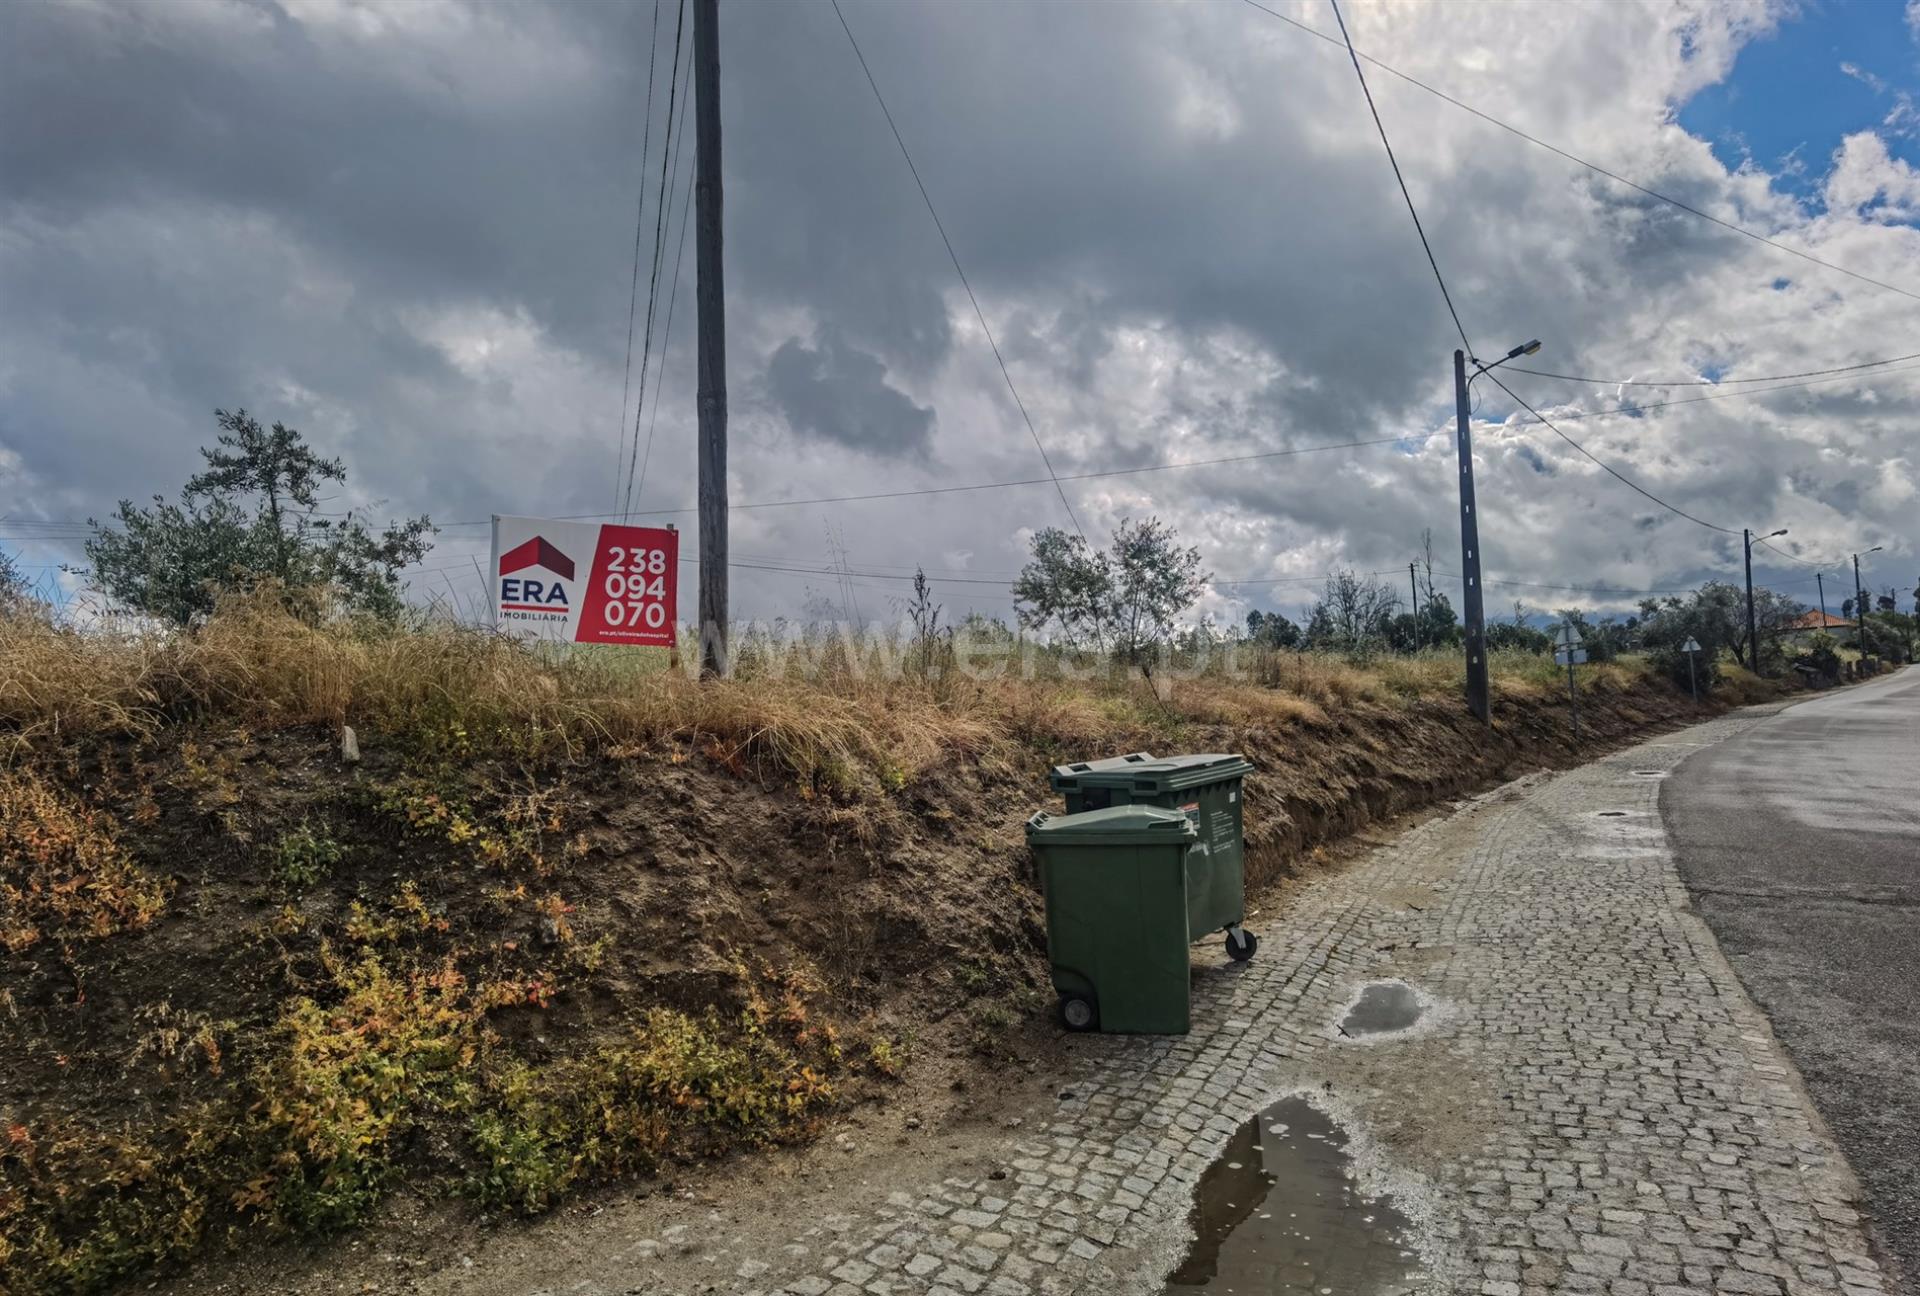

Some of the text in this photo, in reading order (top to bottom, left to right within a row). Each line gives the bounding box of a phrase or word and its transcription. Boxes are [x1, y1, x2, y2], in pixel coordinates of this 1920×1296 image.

[607, 546, 667, 575] 238
[501, 578, 569, 605] ERA
[604, 573, 667, 601] 094
[499, 611, 569, 623] IMOBILIÁRIA
[604, 600, 666, 629] 070
